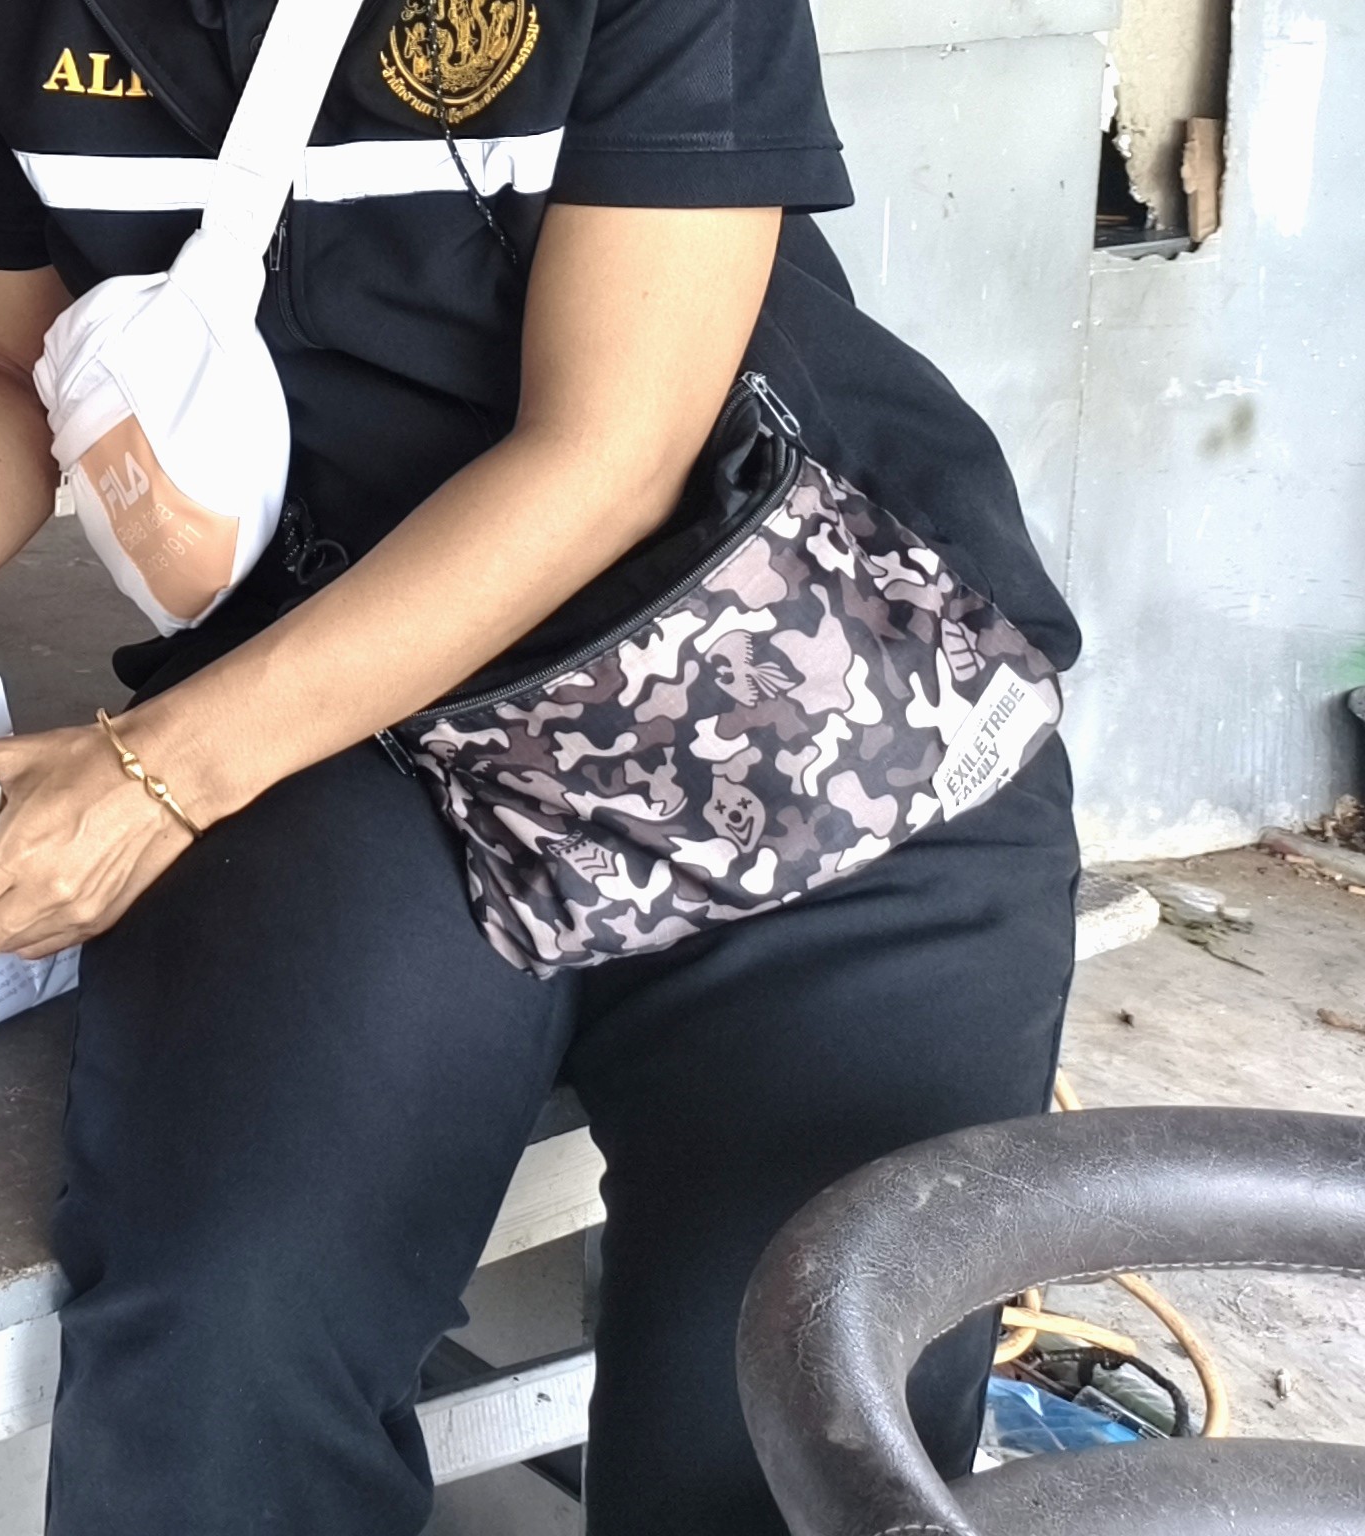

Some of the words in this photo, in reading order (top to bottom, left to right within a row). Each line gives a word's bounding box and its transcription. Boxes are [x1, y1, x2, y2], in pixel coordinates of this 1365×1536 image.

[99, 451, 149, 521] FILA
[161, 523, 203, 557] 1911
[946, 736, 987, 796] EXILE
[980, 682, 1025, 739] TRIBE
[955, 742, 1000, 806] FAMILY
